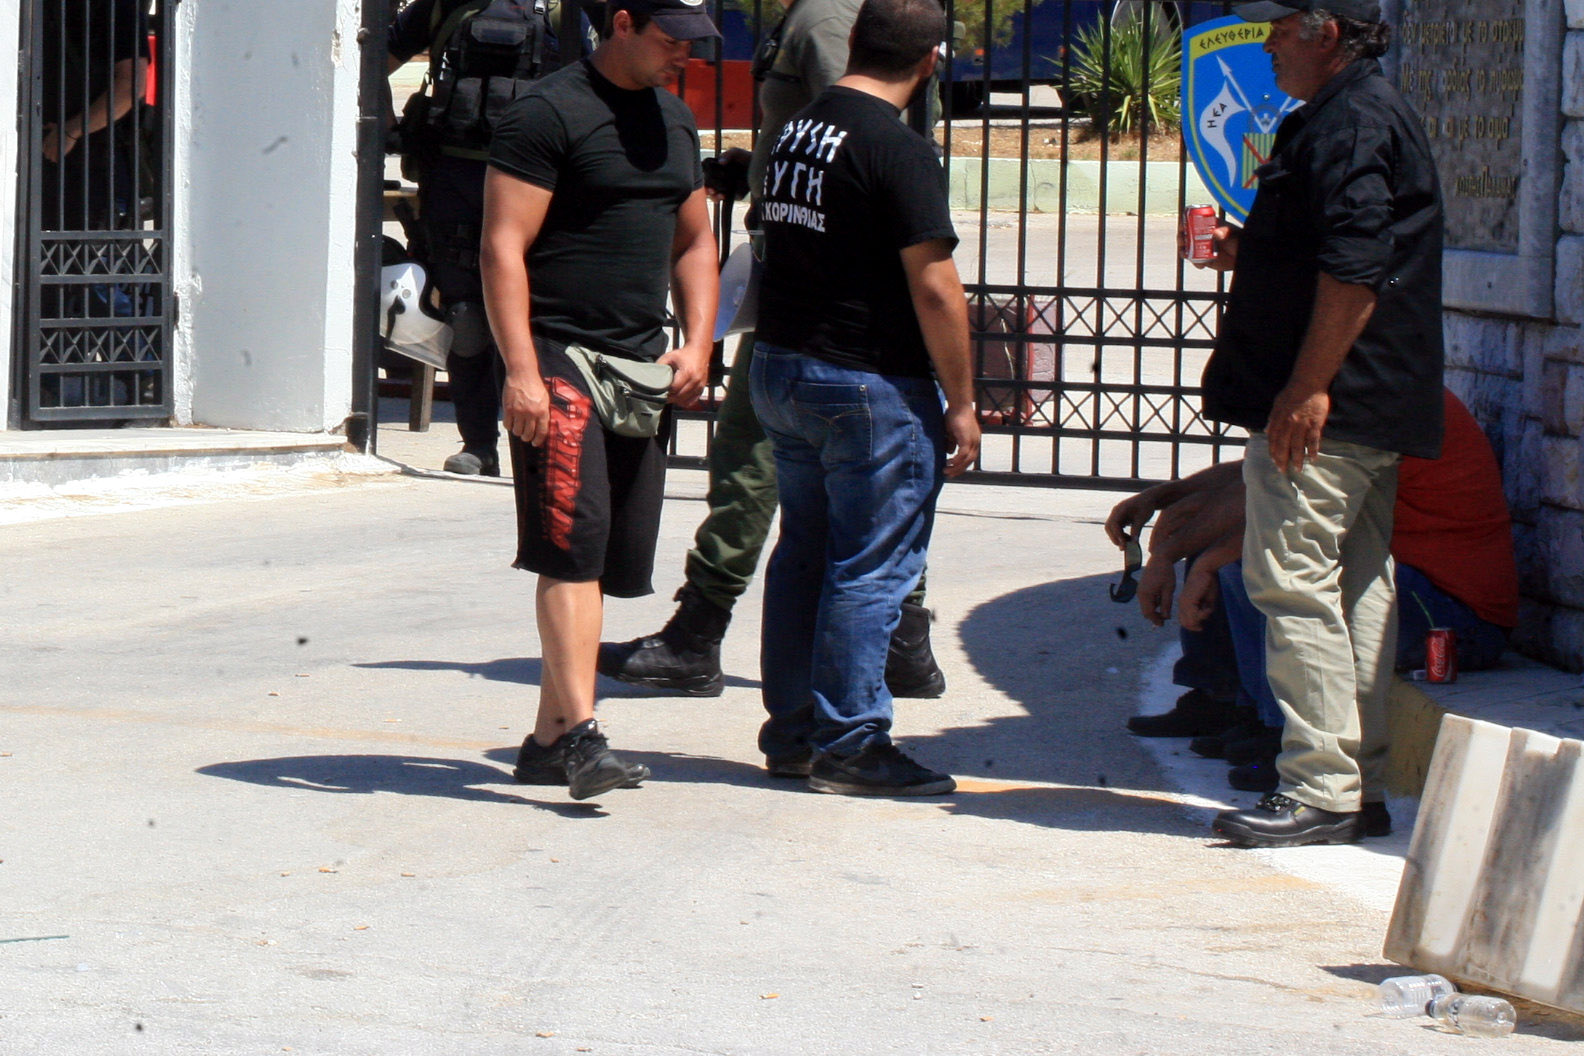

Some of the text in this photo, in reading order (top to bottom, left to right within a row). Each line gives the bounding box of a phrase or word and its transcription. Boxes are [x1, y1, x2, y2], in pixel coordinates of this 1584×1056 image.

[1199, 26, 1265, 50] ΕΛΕΥΘΕΡΙΑ
[771, 119, 847, 163] ΡΥΣΗ
[763, 161, 824, 206] ΥΓΗ
